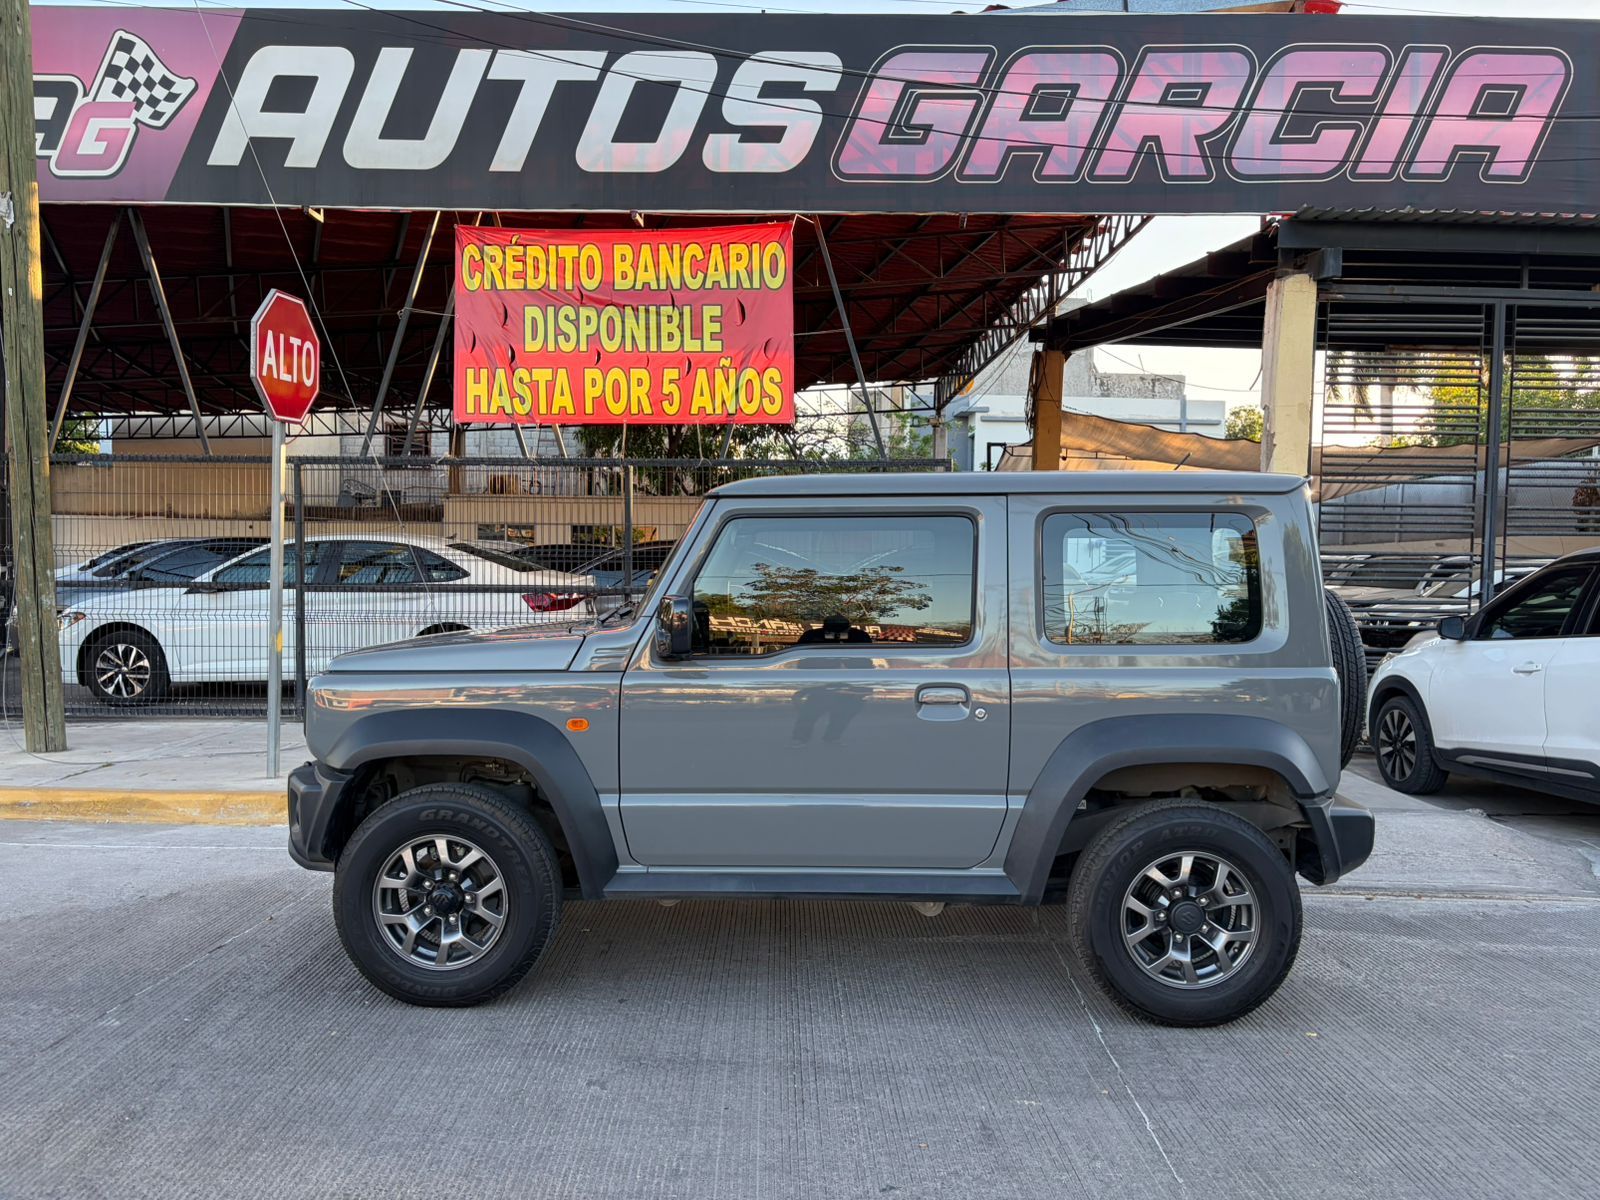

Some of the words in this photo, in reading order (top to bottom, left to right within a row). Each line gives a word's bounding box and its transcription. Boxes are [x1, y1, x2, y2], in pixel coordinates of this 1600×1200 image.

[206, 45, 844, 173] AUTOS
[831, 43, 1574, 184] GARCIA
[461, 235, 603, 291] CRÉDITO
[612, 240, 787, 290] BANCARIO
[523, 304, 724, 353] DISPONIBLE
[262, 329, 315, 388] ALTO
[465, 366, 575, 416] HASTA
[583, 366, 653, 416] POR
[661, 366, 681, 416] 5
[689, 356, 783, 416] AÑOS
